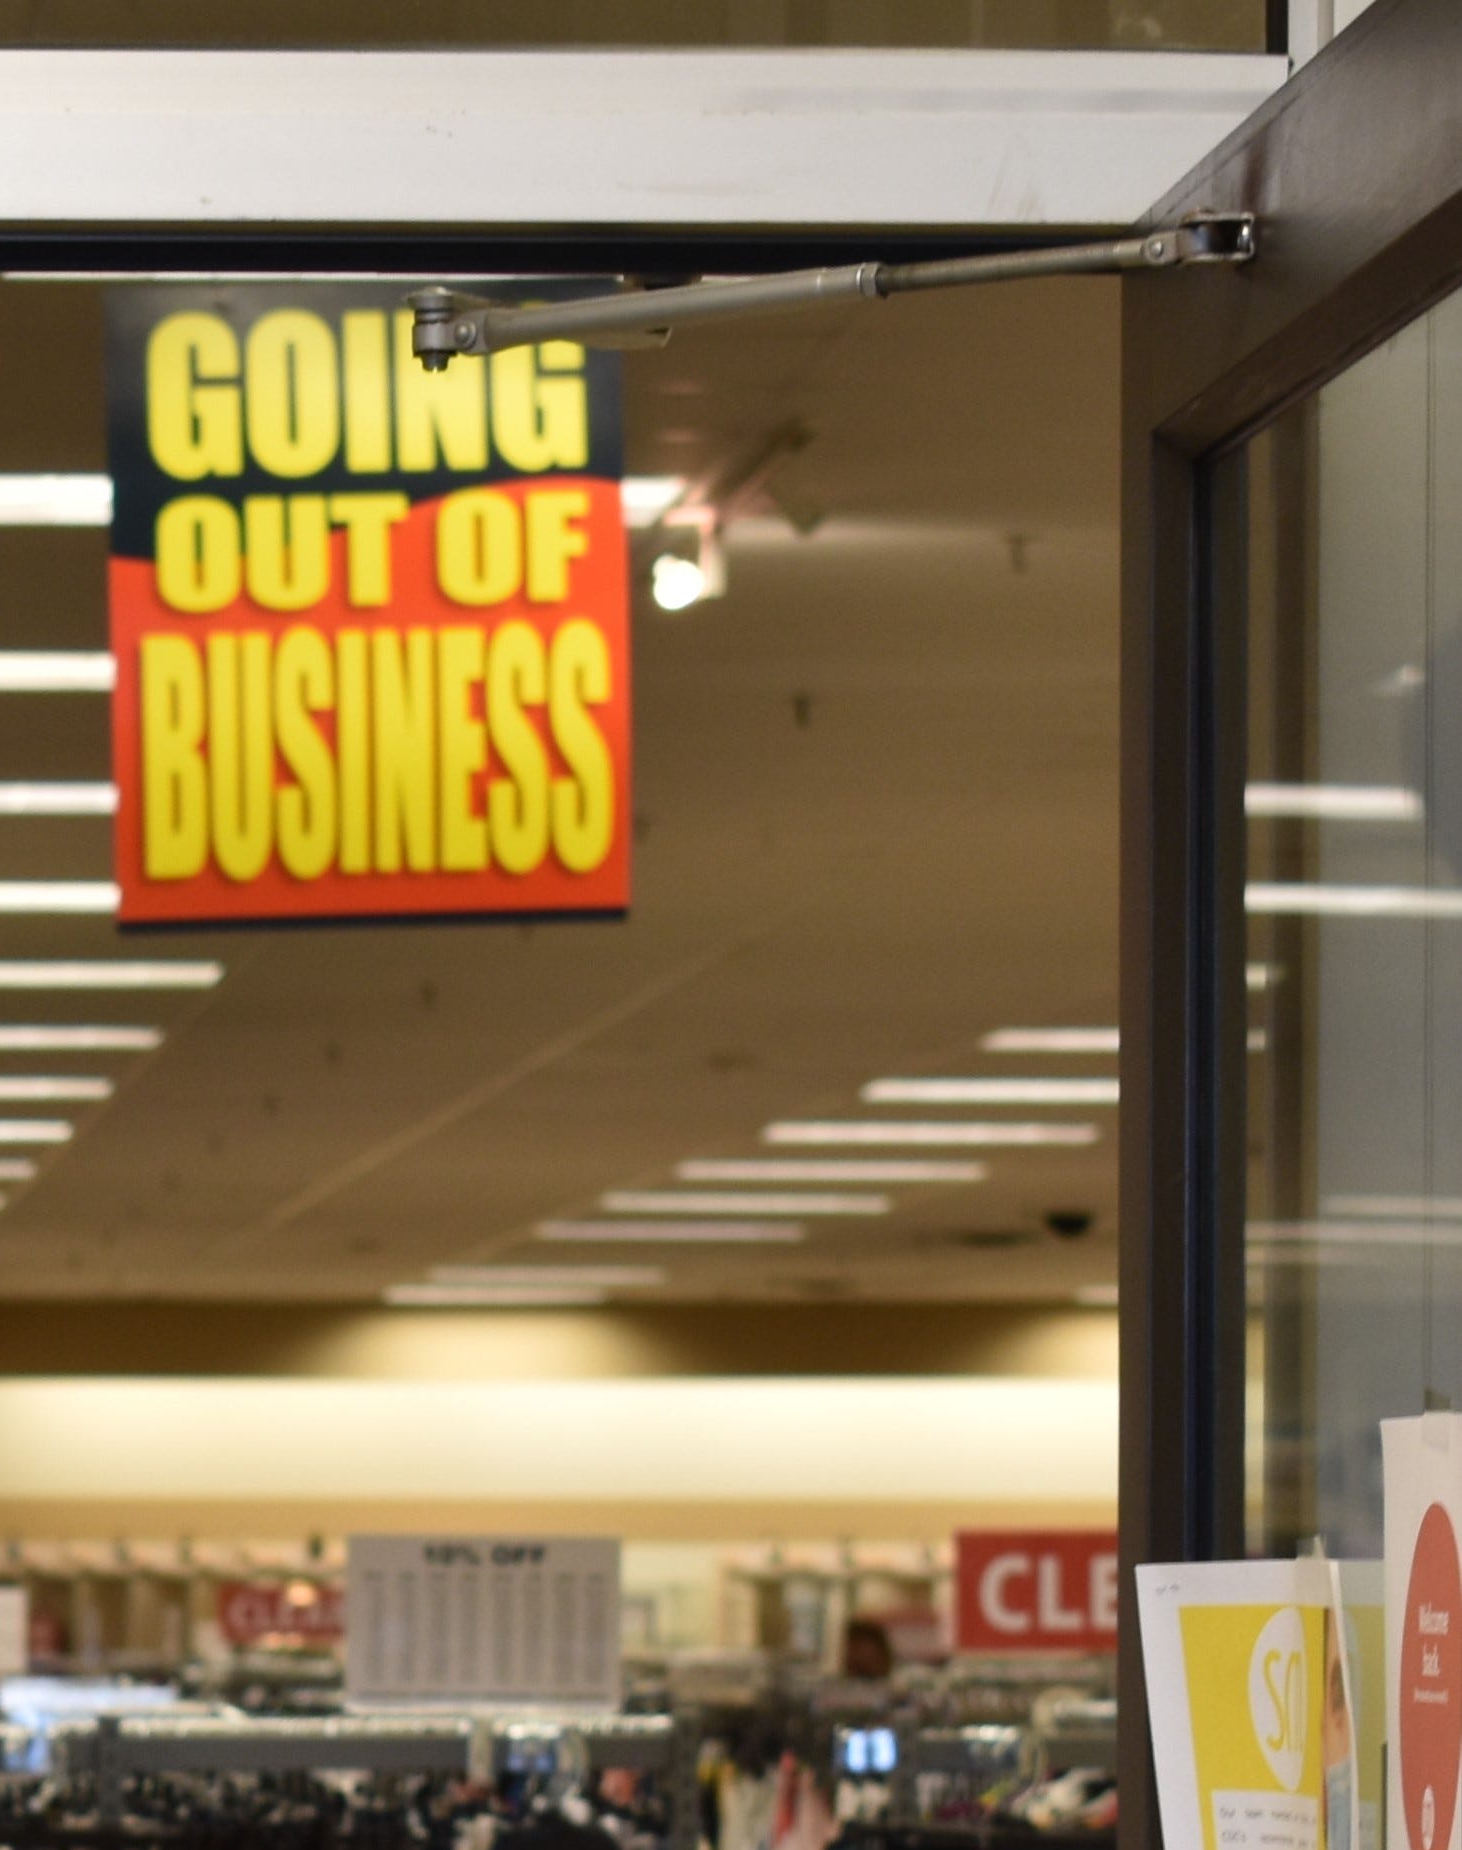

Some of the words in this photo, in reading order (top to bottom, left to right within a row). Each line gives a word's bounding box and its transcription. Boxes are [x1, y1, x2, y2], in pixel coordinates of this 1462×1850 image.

[144, 308, 588, 480] GOING
[154, 494, 409, 615] OUT
[436, 487, 590, 607] OF
[139, 619, 615, 884] BUSINESS
